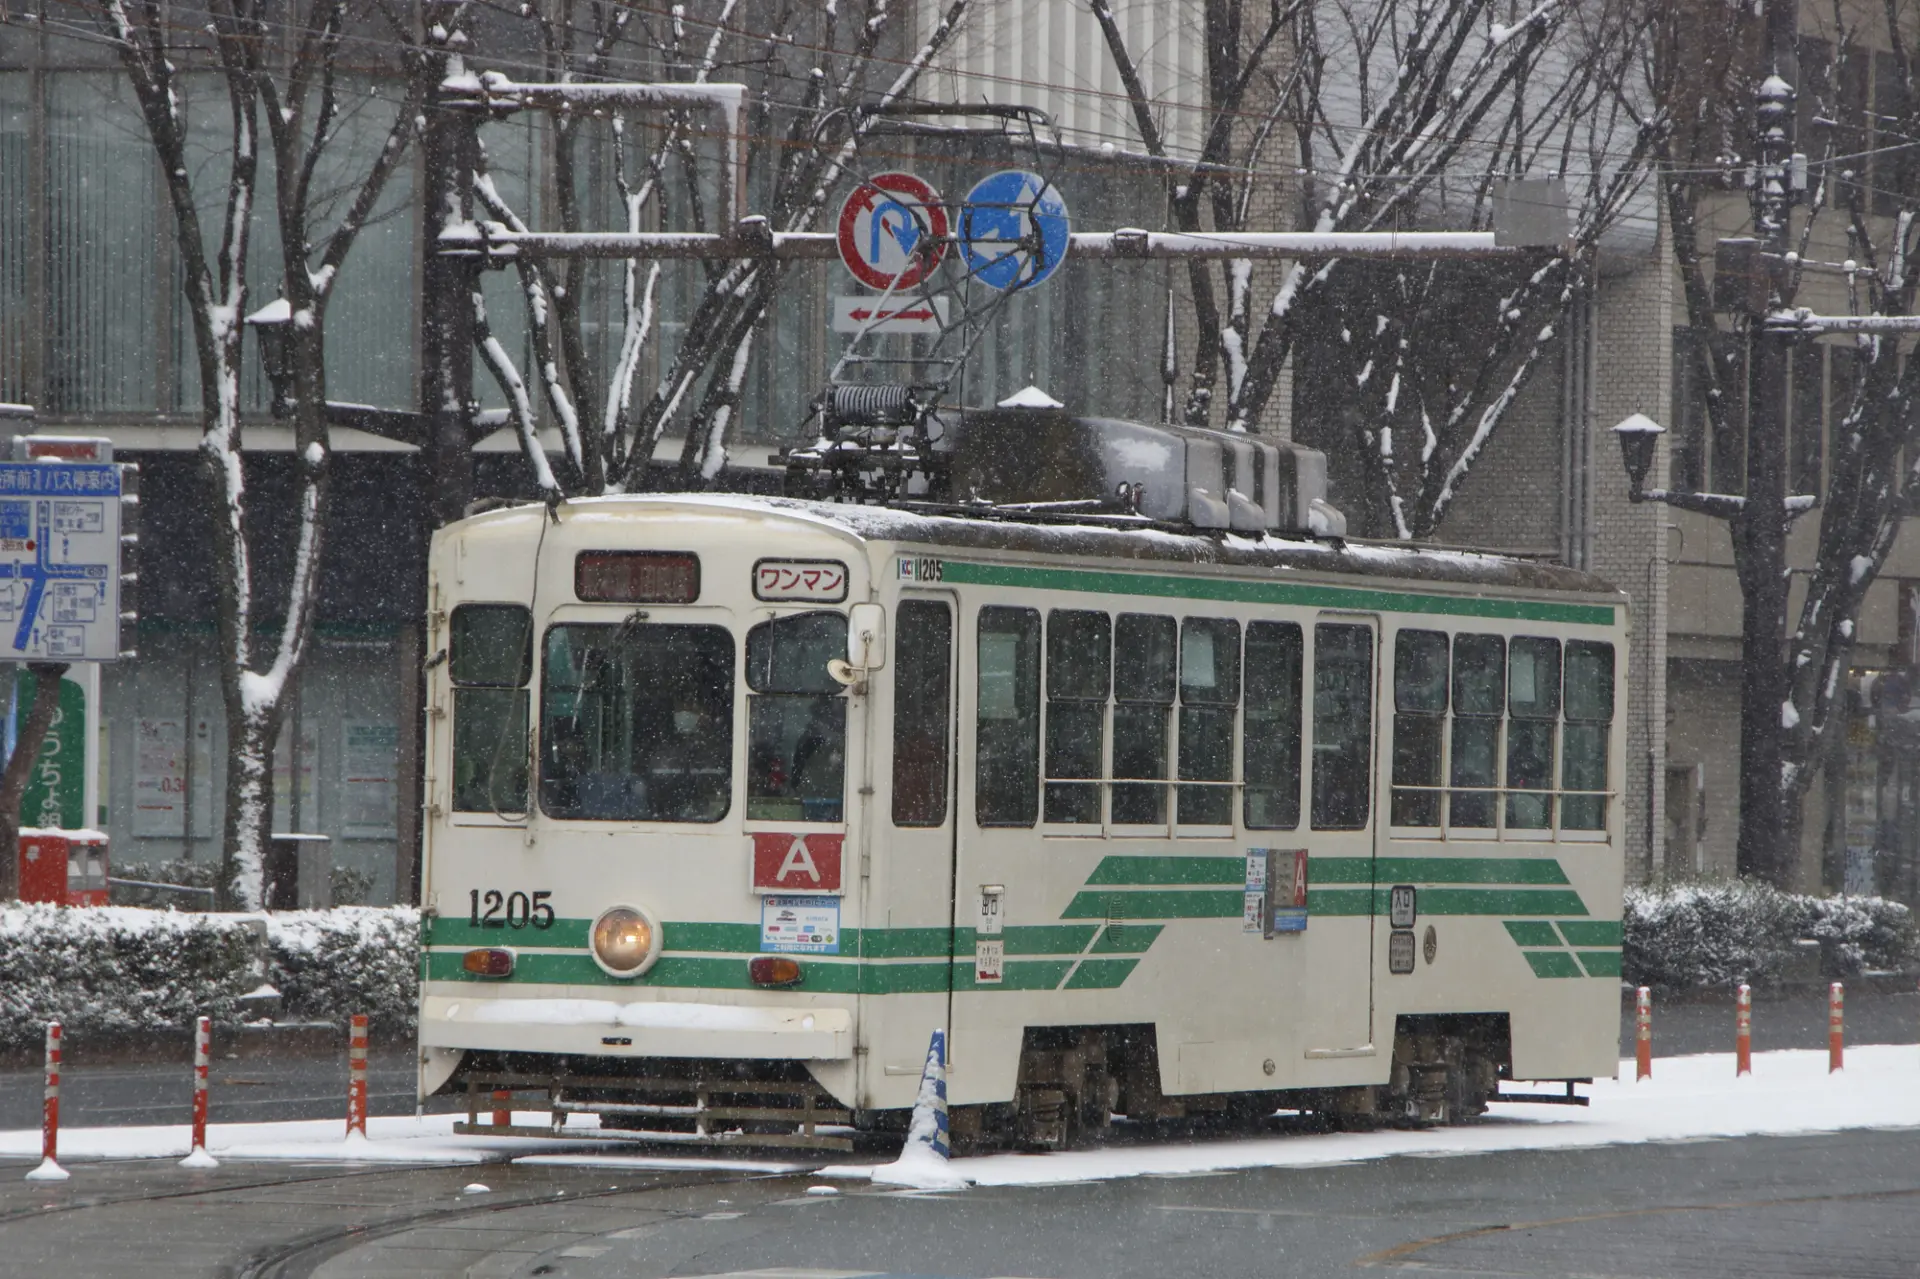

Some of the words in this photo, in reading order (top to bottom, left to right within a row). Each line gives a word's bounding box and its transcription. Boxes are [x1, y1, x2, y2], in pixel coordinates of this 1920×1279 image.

[761, 568, 842, 591] ワンマン
[919, 557, 943, 582] 1205
[776, 836, 820, 882] A
[1294, 857, 1306, 897] A
[469, 889, 555, 930] 1205
[1395, 890, 1411, 908] 入口
